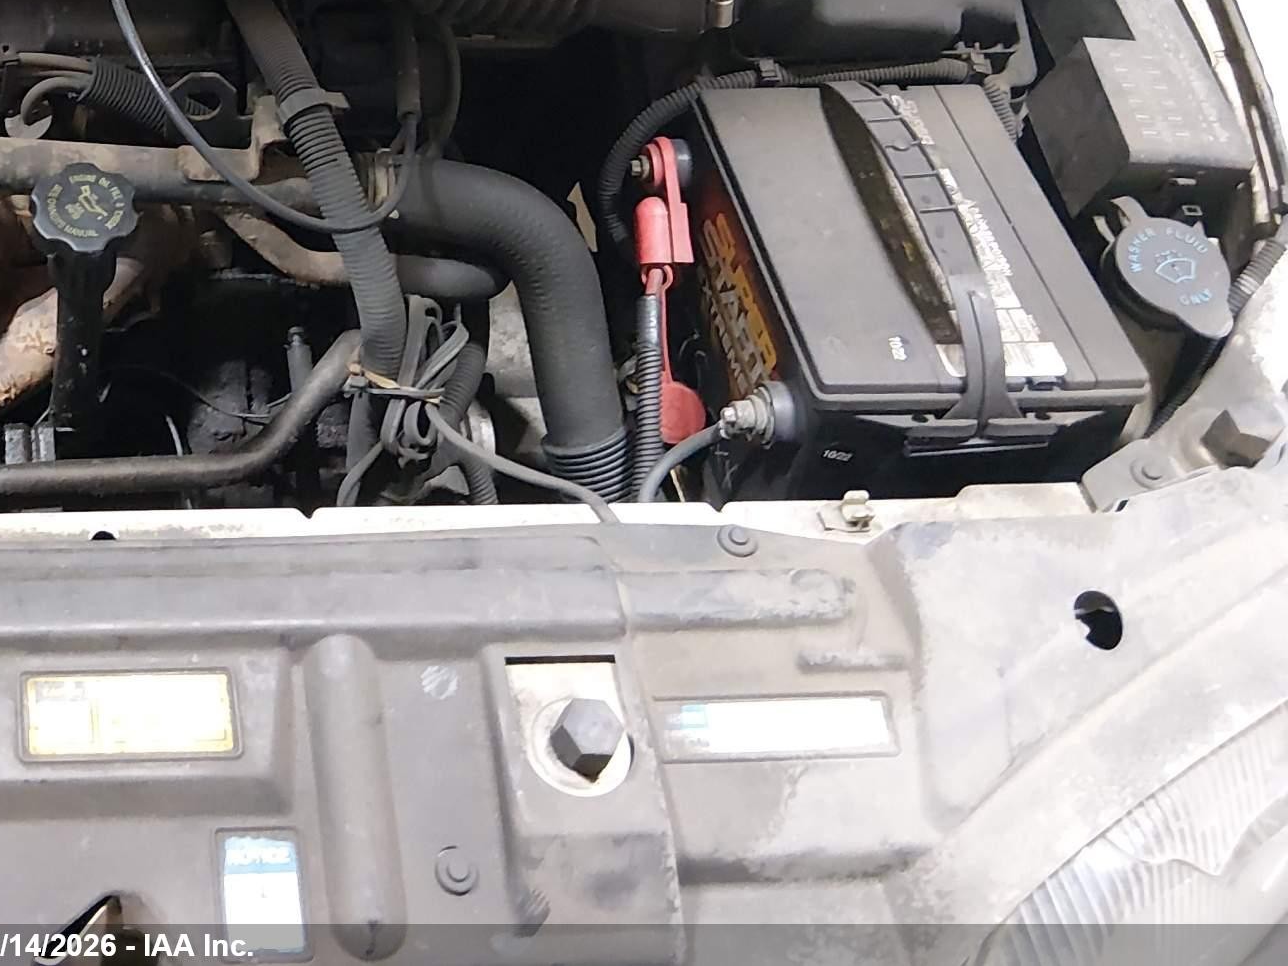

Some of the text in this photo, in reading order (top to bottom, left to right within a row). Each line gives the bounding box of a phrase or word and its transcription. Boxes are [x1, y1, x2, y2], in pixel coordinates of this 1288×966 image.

[68, 174, 97, 184] ENGINE
[98, 177, 111, 188] OIL
[64, 224, 99, 237] MANUAL
[1127, 227, 1209, 273] WASHER FLUID
